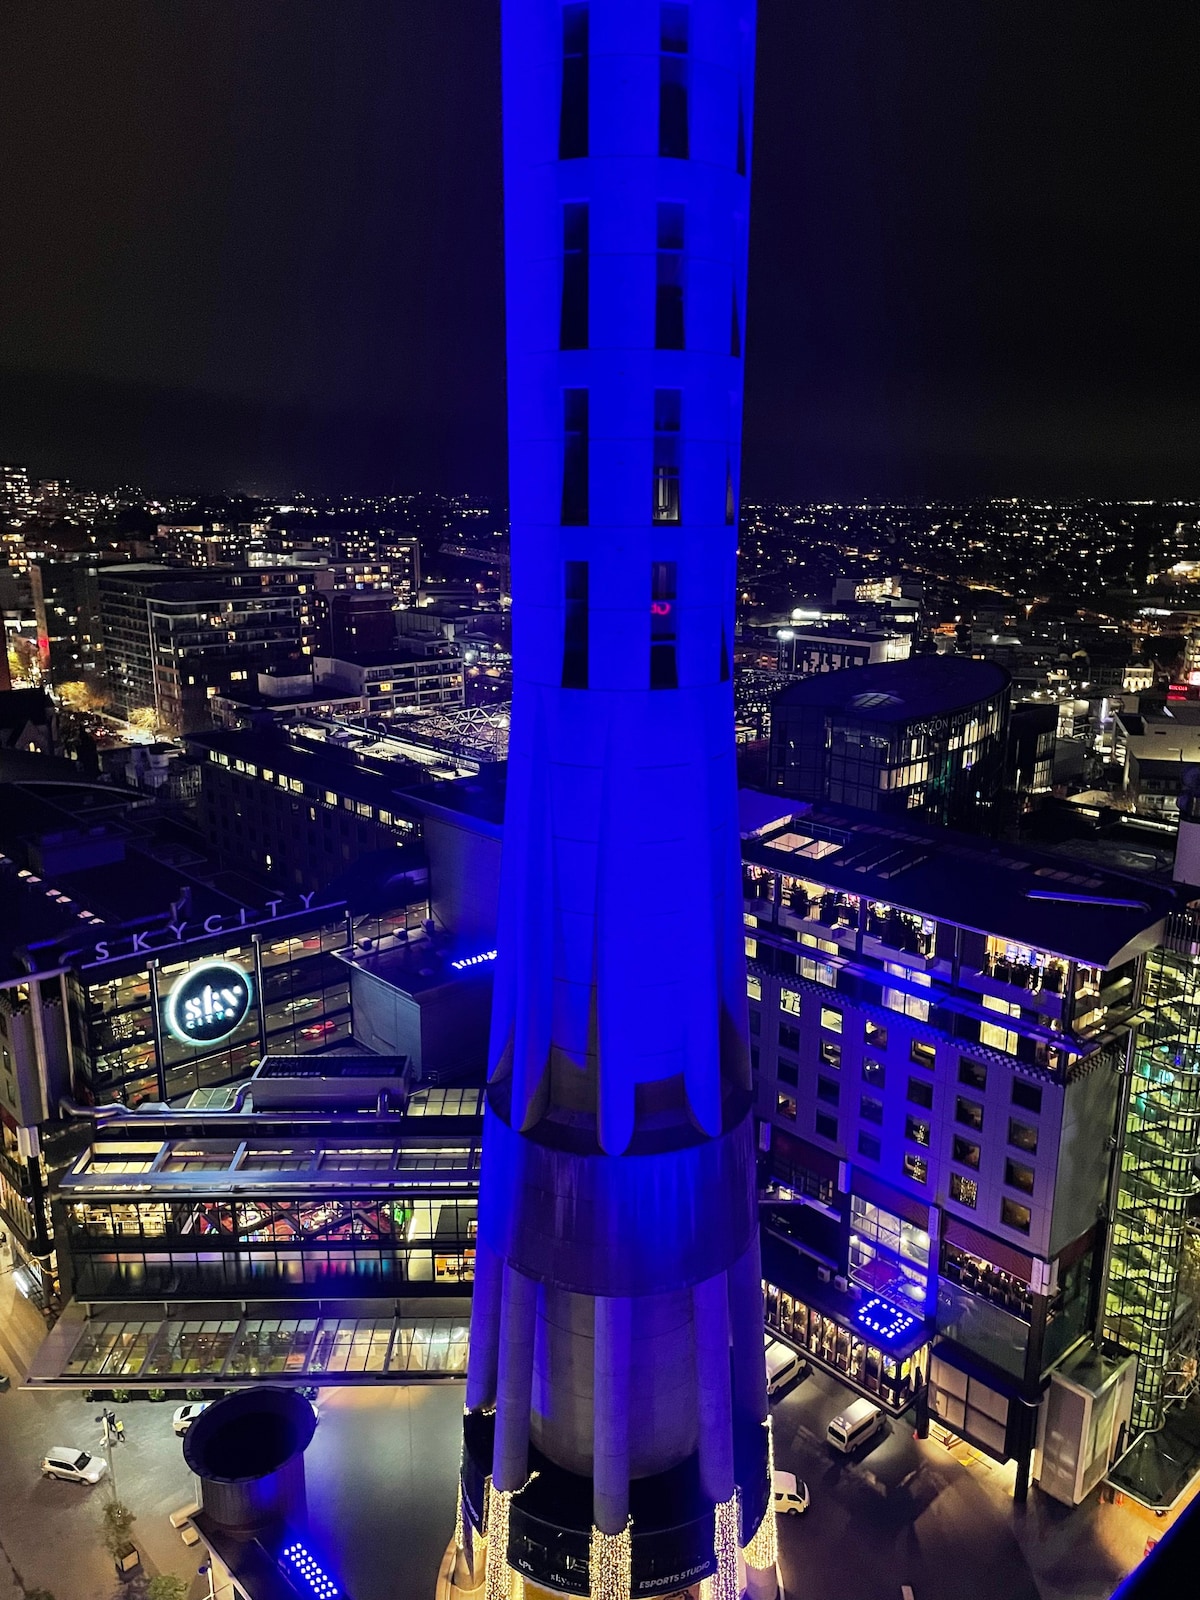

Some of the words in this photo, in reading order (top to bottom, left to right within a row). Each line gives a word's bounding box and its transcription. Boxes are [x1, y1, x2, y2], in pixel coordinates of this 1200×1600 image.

[906, 718, 948, 738] HORIZON
[95, 891, 315, 961] SKYCITY
[639, 1574, 680, 1589] ESPORTS
[680, 1560, 711, 1580] STUDIO
